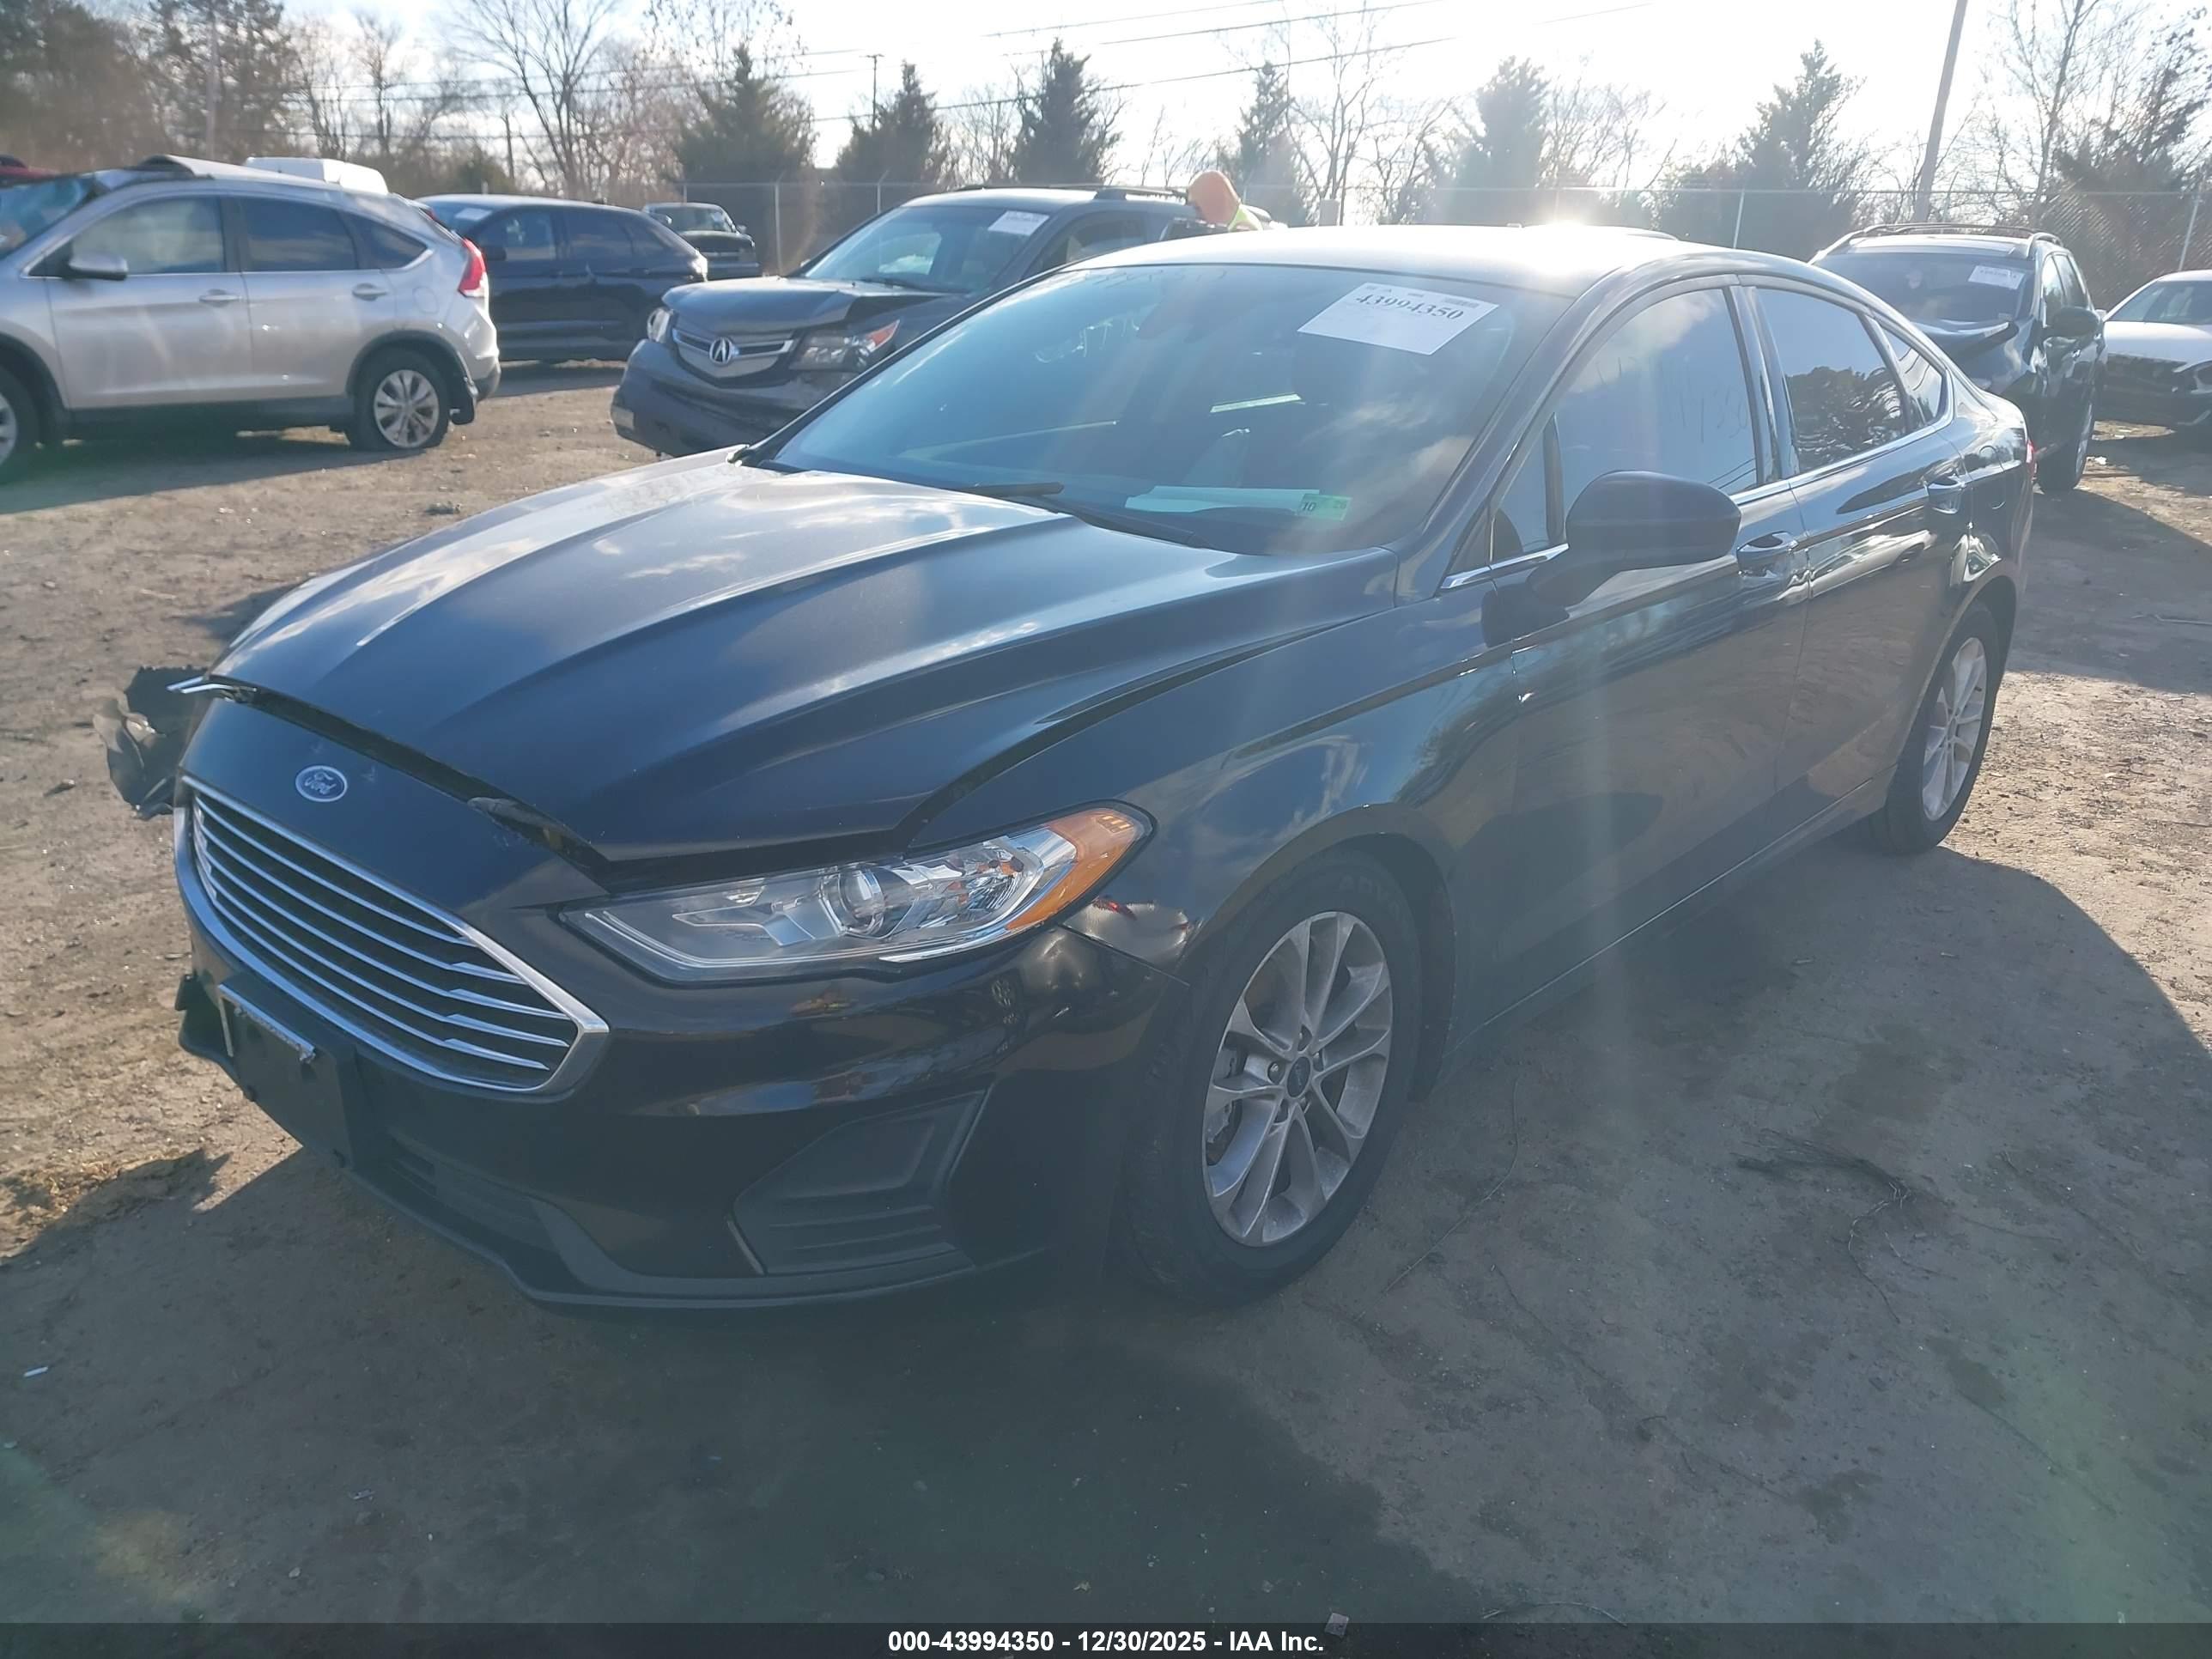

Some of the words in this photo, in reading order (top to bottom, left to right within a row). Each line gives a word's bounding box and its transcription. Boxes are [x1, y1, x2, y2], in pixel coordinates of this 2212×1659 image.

[1356, 294, 1464, 319] 43994350
[1302, 501, 1316, 512] 10
[305, 771, 337, 795] Ford
